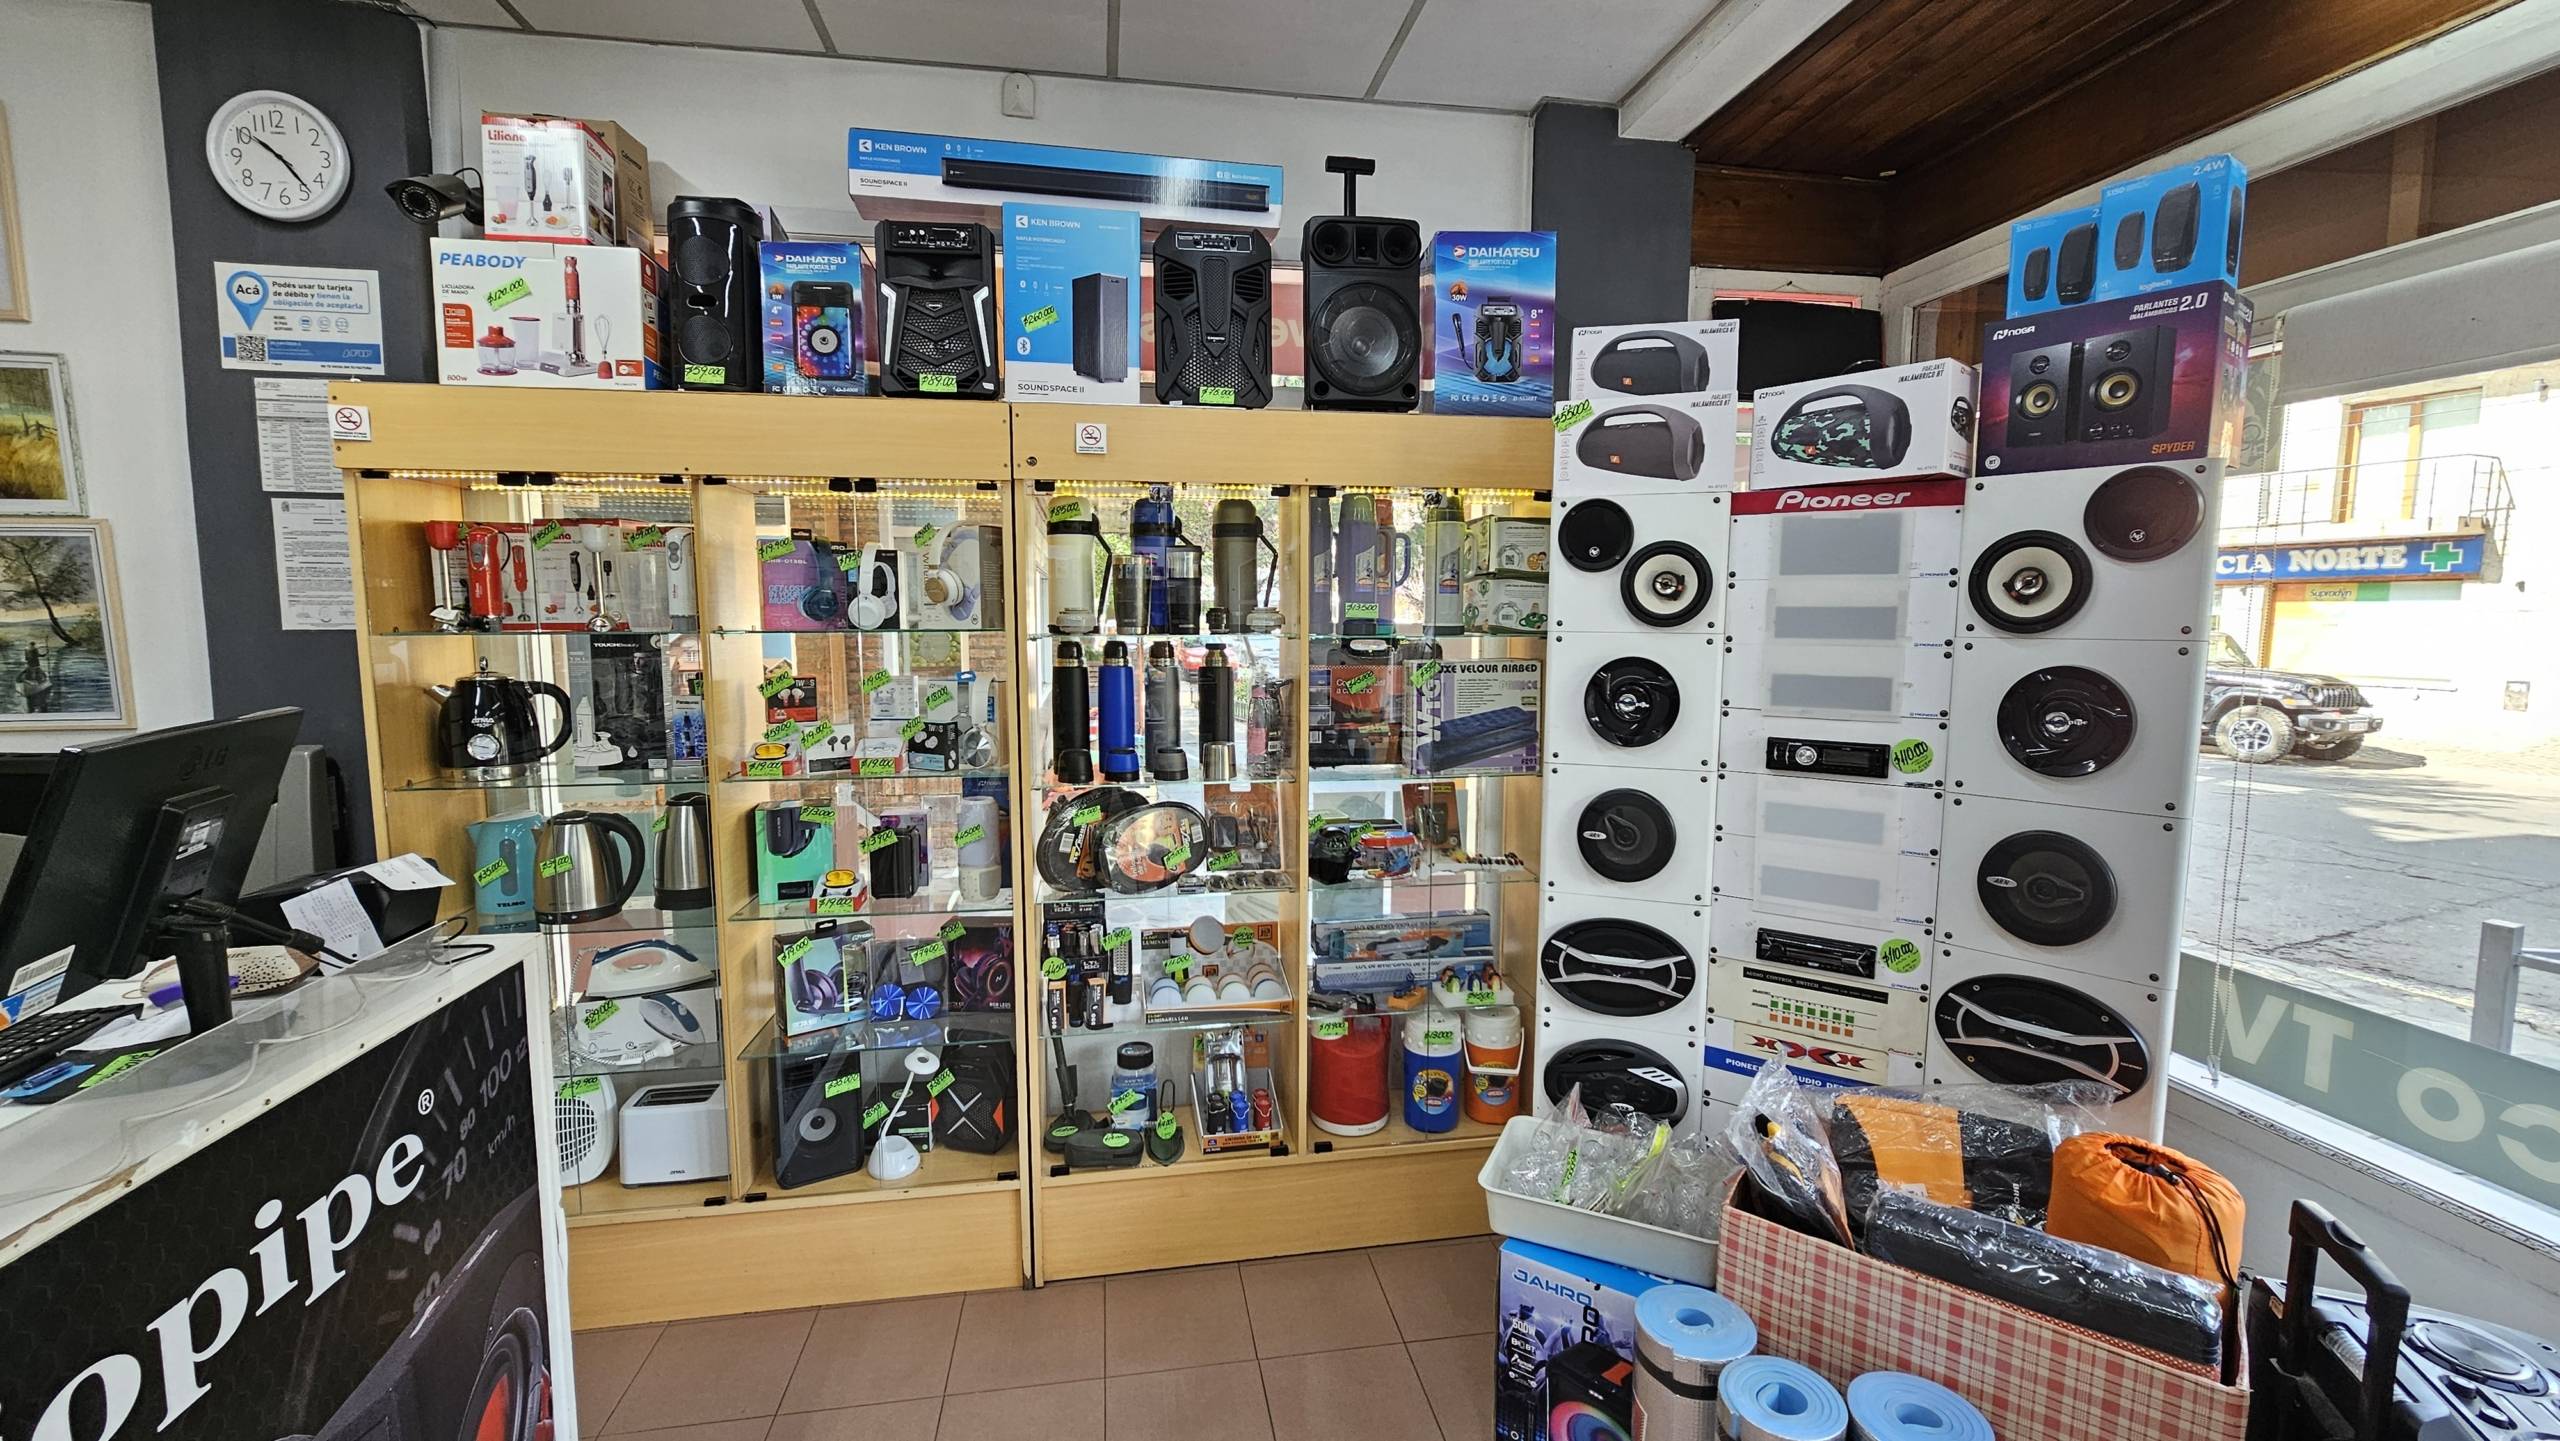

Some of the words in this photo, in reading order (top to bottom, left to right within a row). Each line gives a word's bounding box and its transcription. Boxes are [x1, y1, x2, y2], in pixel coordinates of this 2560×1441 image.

[253, 115, 265, 132] 11
[269, 110, 284, 128] 12
[295, 116, 299, 134] 1
[236, 127, 251, 144] 10
[308, 129, 320, 146] 2
[230, 148, 242, 165] 9
[894, 145, 927, 154] BROWN
[320, 151, 331, 168] 3
[2193, 160, 2226, 176] 2.4W
[242, 169, 253, 187] 8
[313, 173, 324, 189] 4
[260, 183, 272, 200] 7
[280, 188, 291, 205] 6
[300, 184, 310, 201] 5
[1031, 218, 1047, 227] KEN
[1048, 220, 1080, 229] BROWN
[439, 252, 527, 269] PEABODY
[785, 255, 846, 264] DAIHATSU
[1468, 247, 1539, 258] DAIHATSU
[236, 284, 260, 295] Acá
[272, 281, 296, 289] Podés
[327, 284, 353, 292] tarjeta
[2134, 298, 2178, 313] PARLANTES
[2180, 292, 2208, 311] 2.0
[1017, 383, 1077, 394] SOUNDSPACE
[2151, 440, 2196, 454] SPYDER
[1775, 491, 1911, 510] Pioneer
[2288, 545, 2408, 573] NORTE
[1460, 664, 1499, 673] VELOUR
[1502, 664, 1538, 673] AIRBED
[1746, 971, 1764, 979] AUDIO
[1766, 974, 1793, 984] CONTROL
[1796, 980, 1819, 989] SWITCH
[1513, 1269, 1593, 1307] JAHRO
